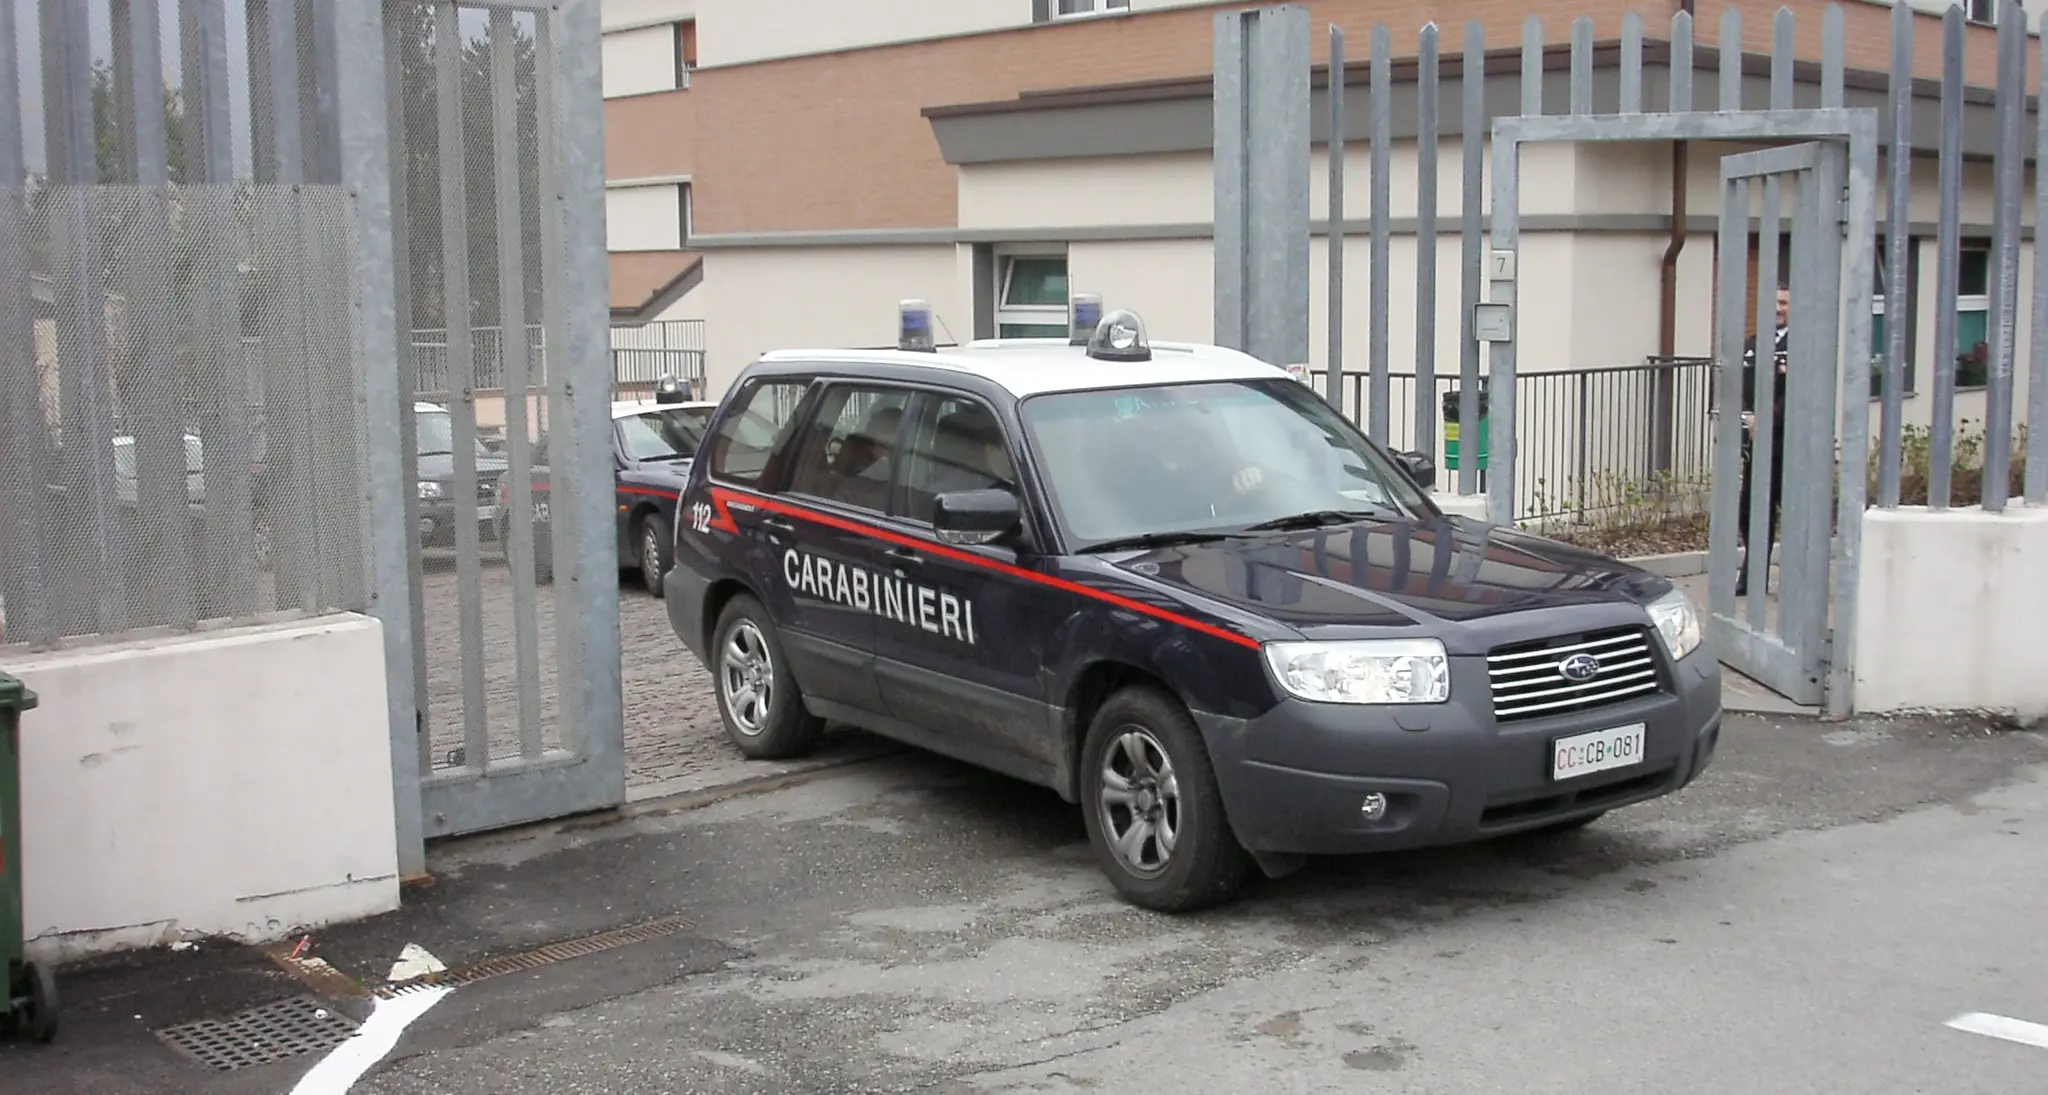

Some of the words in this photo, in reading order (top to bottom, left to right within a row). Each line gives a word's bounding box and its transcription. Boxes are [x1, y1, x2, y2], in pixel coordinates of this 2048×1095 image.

[1496, 256, 1507, 274] 7
[691, 501, 712, 534] 112
[783, 548, 975, 644] CARABINIERI
